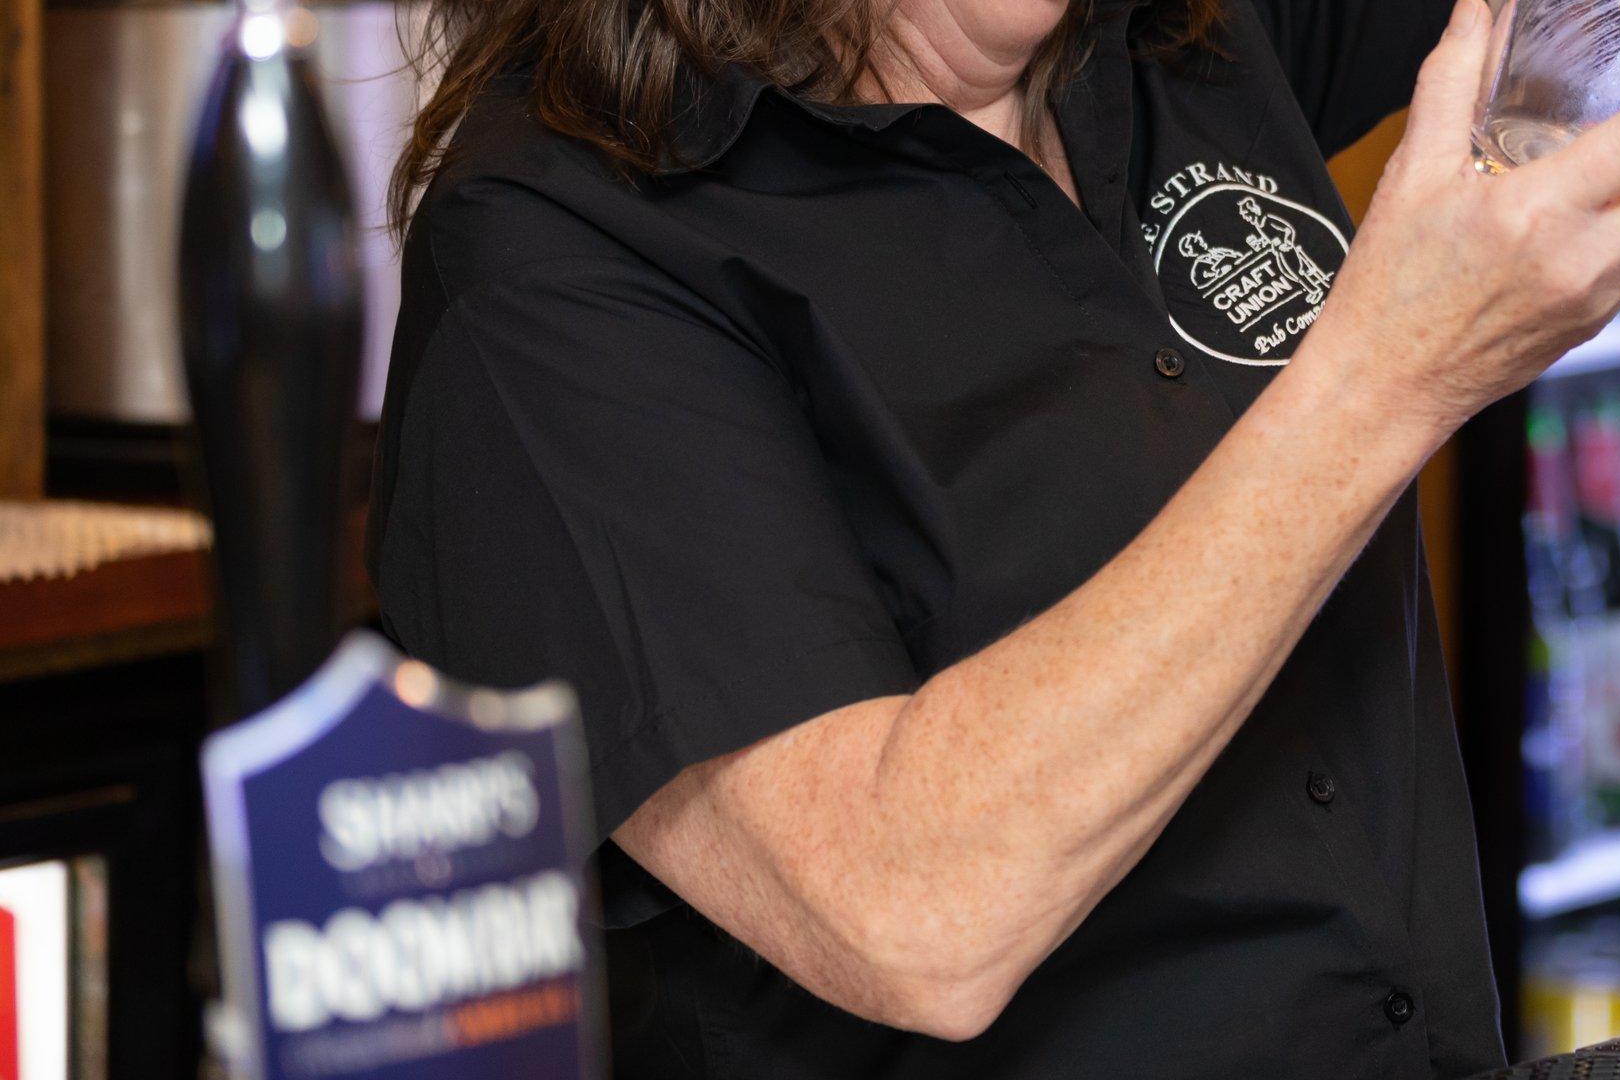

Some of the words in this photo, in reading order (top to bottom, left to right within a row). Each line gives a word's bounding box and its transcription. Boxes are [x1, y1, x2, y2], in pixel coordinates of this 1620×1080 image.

[1149, 162, 1278, 215] STRAND
[1213, 259, 1272, 310] CRAFT
[1227, 276, 1293, 324] UNION
[1254, 323, 1287, 355] Pub
